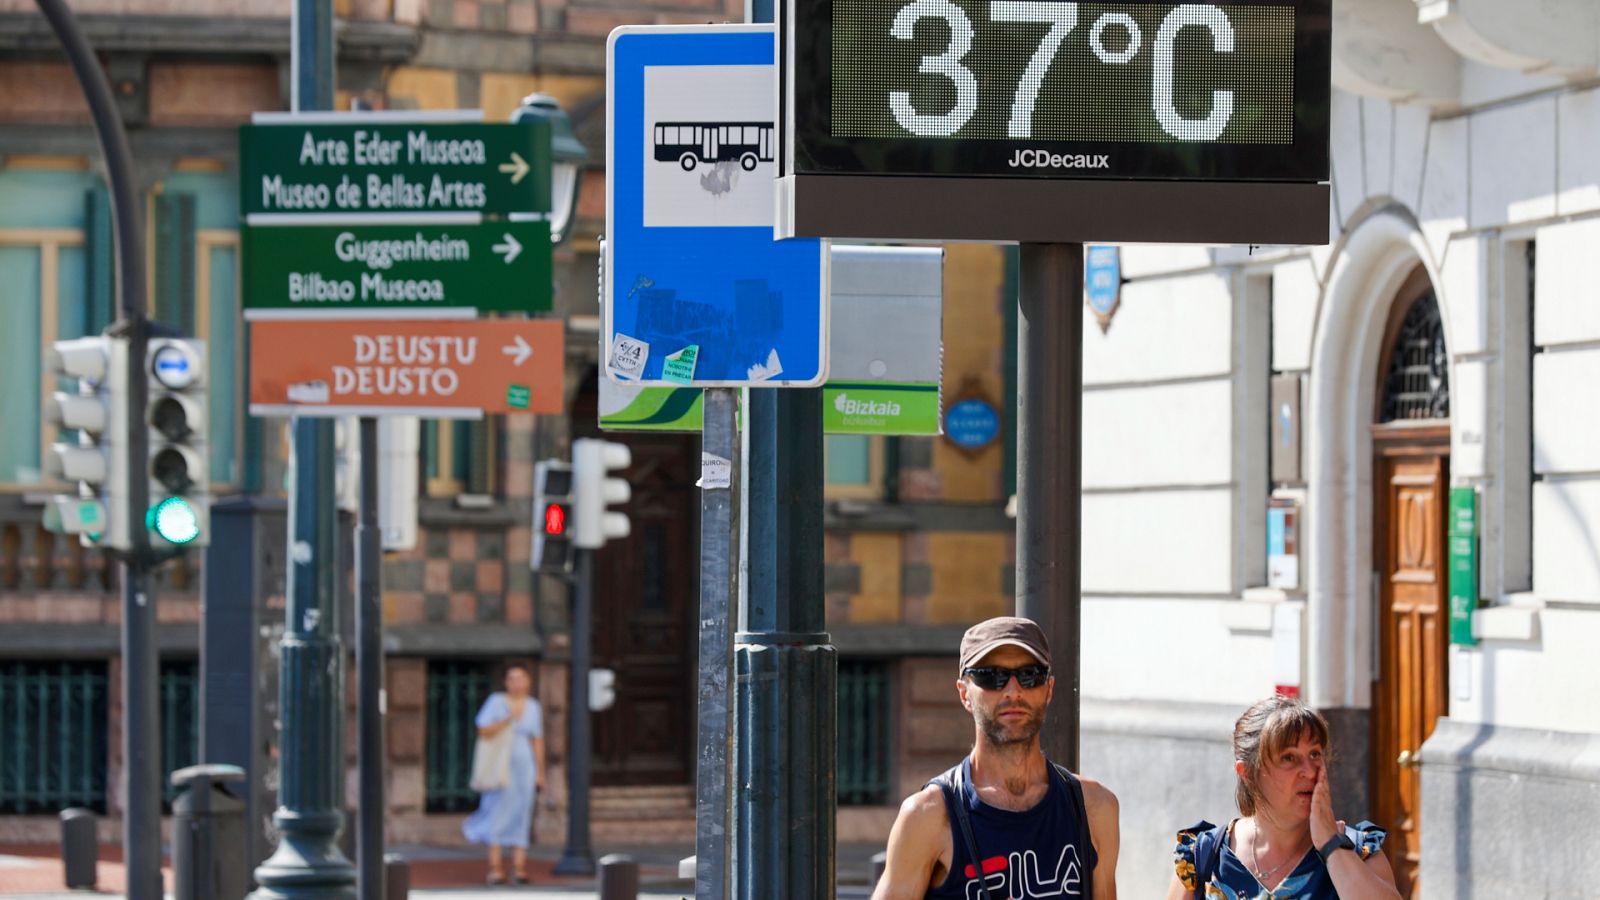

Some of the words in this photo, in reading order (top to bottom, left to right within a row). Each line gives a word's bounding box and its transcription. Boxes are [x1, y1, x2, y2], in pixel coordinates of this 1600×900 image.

[300, 131, 349, 165] Arte
[354, 131, 402, 165] Eder
[407, 131, 486, 165] Museoa
[1008, 149, 1109, 169] JCDecaux
[262, 175, 330, 208] Museo
[335, 174, 361, 207] de
[367, 174, 425, 207] Bellas
[428, 174, 486, 207] Artes
[335, 232, 469, 269] Guggenheim
[289, 272, 355, 302] Bilbao
[360, 272, 444, 302] Museoa
[353, 335, 477, 365] DEUSTU
[332, 366, 459, 396] DEUSTO
[845, 400, 901, 416] Bizkaia
[965, 844, 1081, 900] FILA
